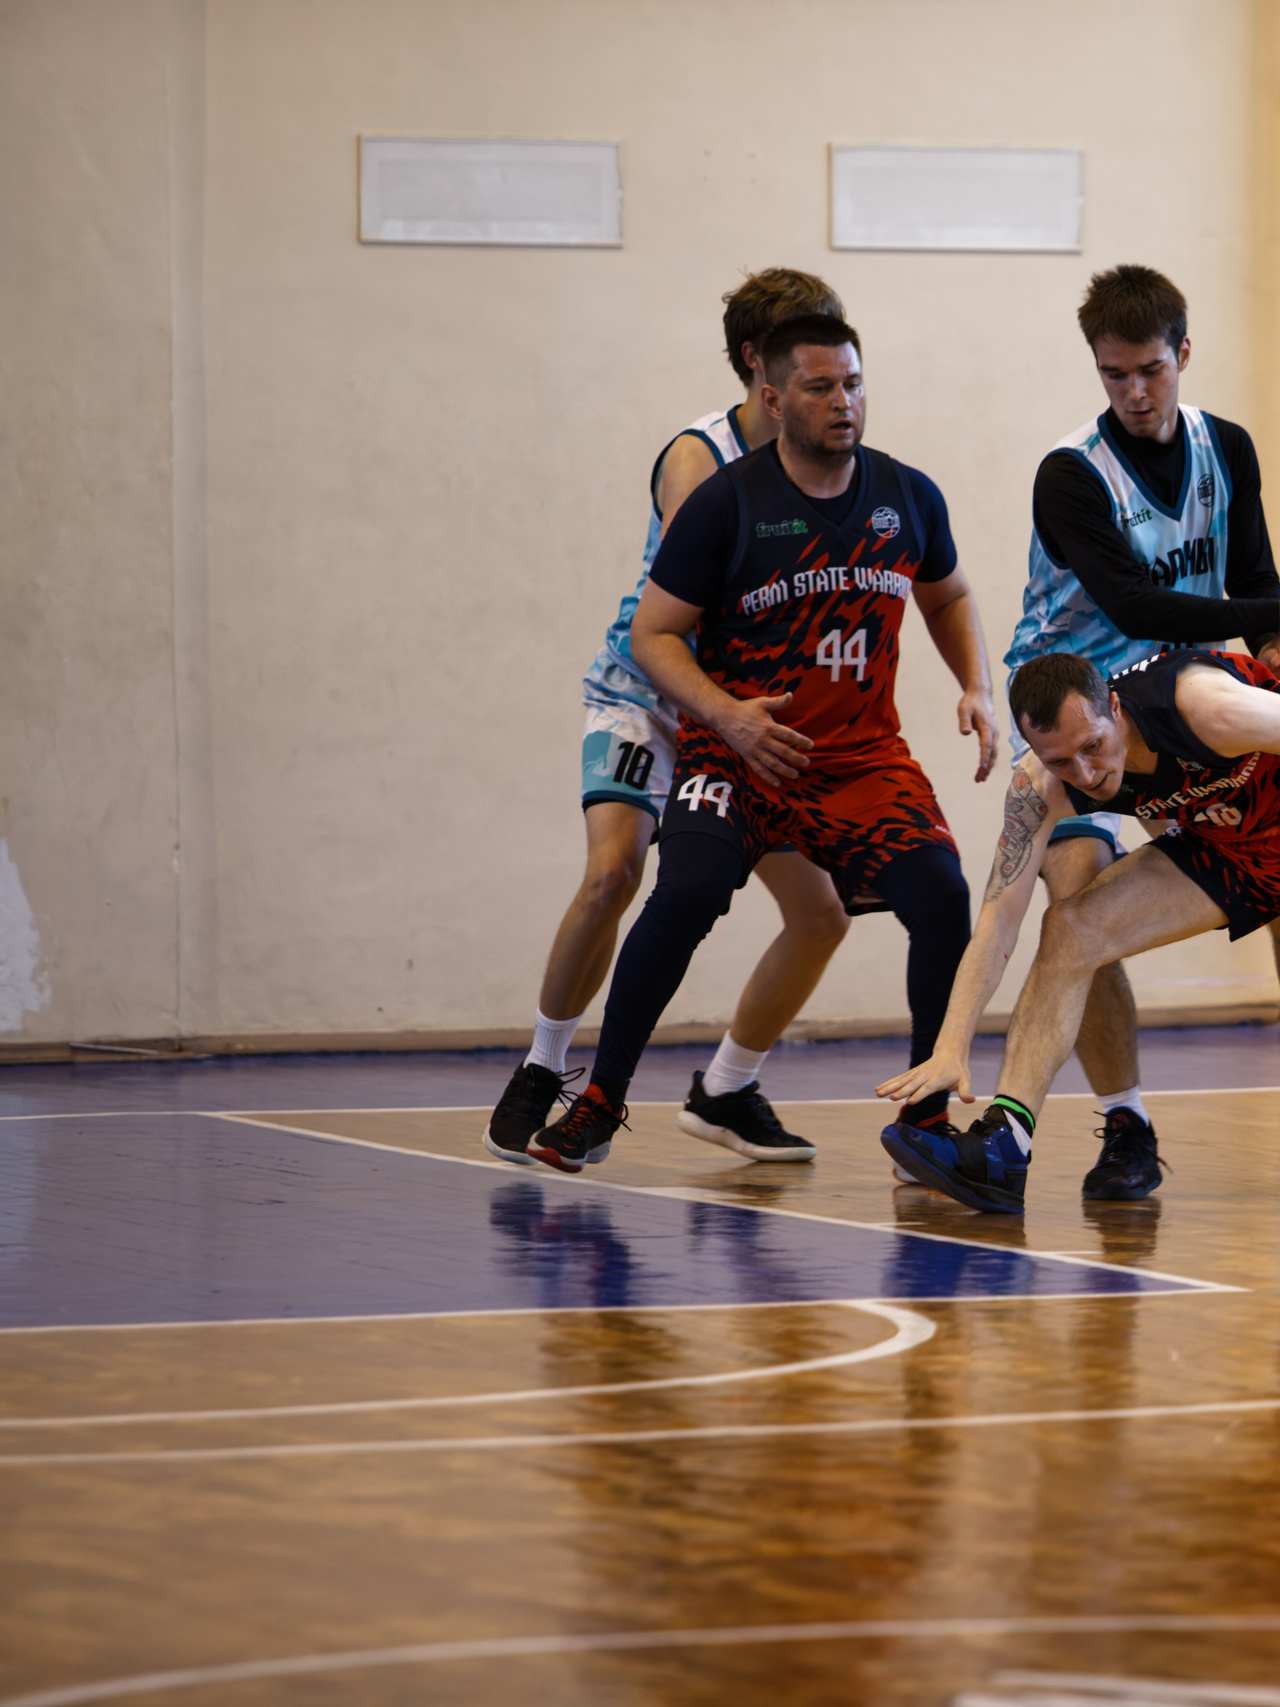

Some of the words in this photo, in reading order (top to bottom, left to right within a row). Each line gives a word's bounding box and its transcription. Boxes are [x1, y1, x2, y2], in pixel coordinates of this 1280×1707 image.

[741, 579, 789, 616] PERM
[793, 566, 850, 598] STATE
[816, 628, 868, 682] 44
[613, 741, 655, 791] 10
[677, 773, 733, 818] 44
